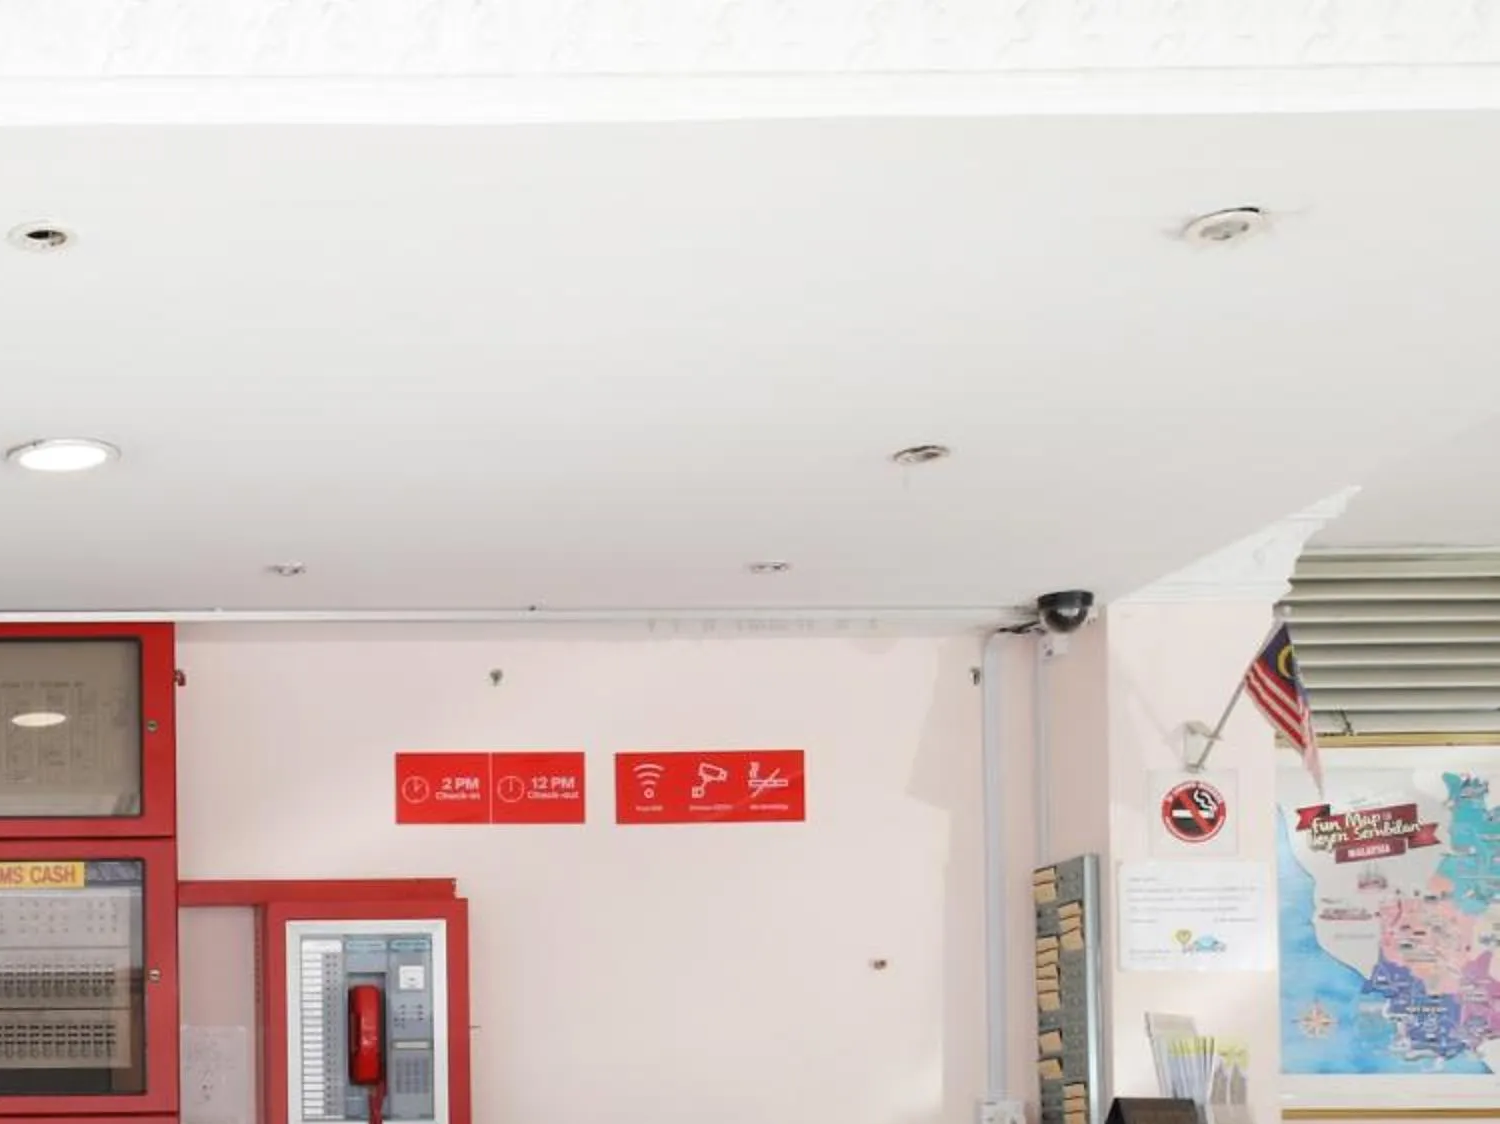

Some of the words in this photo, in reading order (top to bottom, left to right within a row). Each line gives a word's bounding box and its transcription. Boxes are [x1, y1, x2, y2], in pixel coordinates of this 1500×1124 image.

[441, 777, 453, 790] 2
[455, 777, 480, 790] PM
[531, 776, 549, 789] 12
[550, 776, 575, 790] PM
[29, 864, 77, 883] CASH
